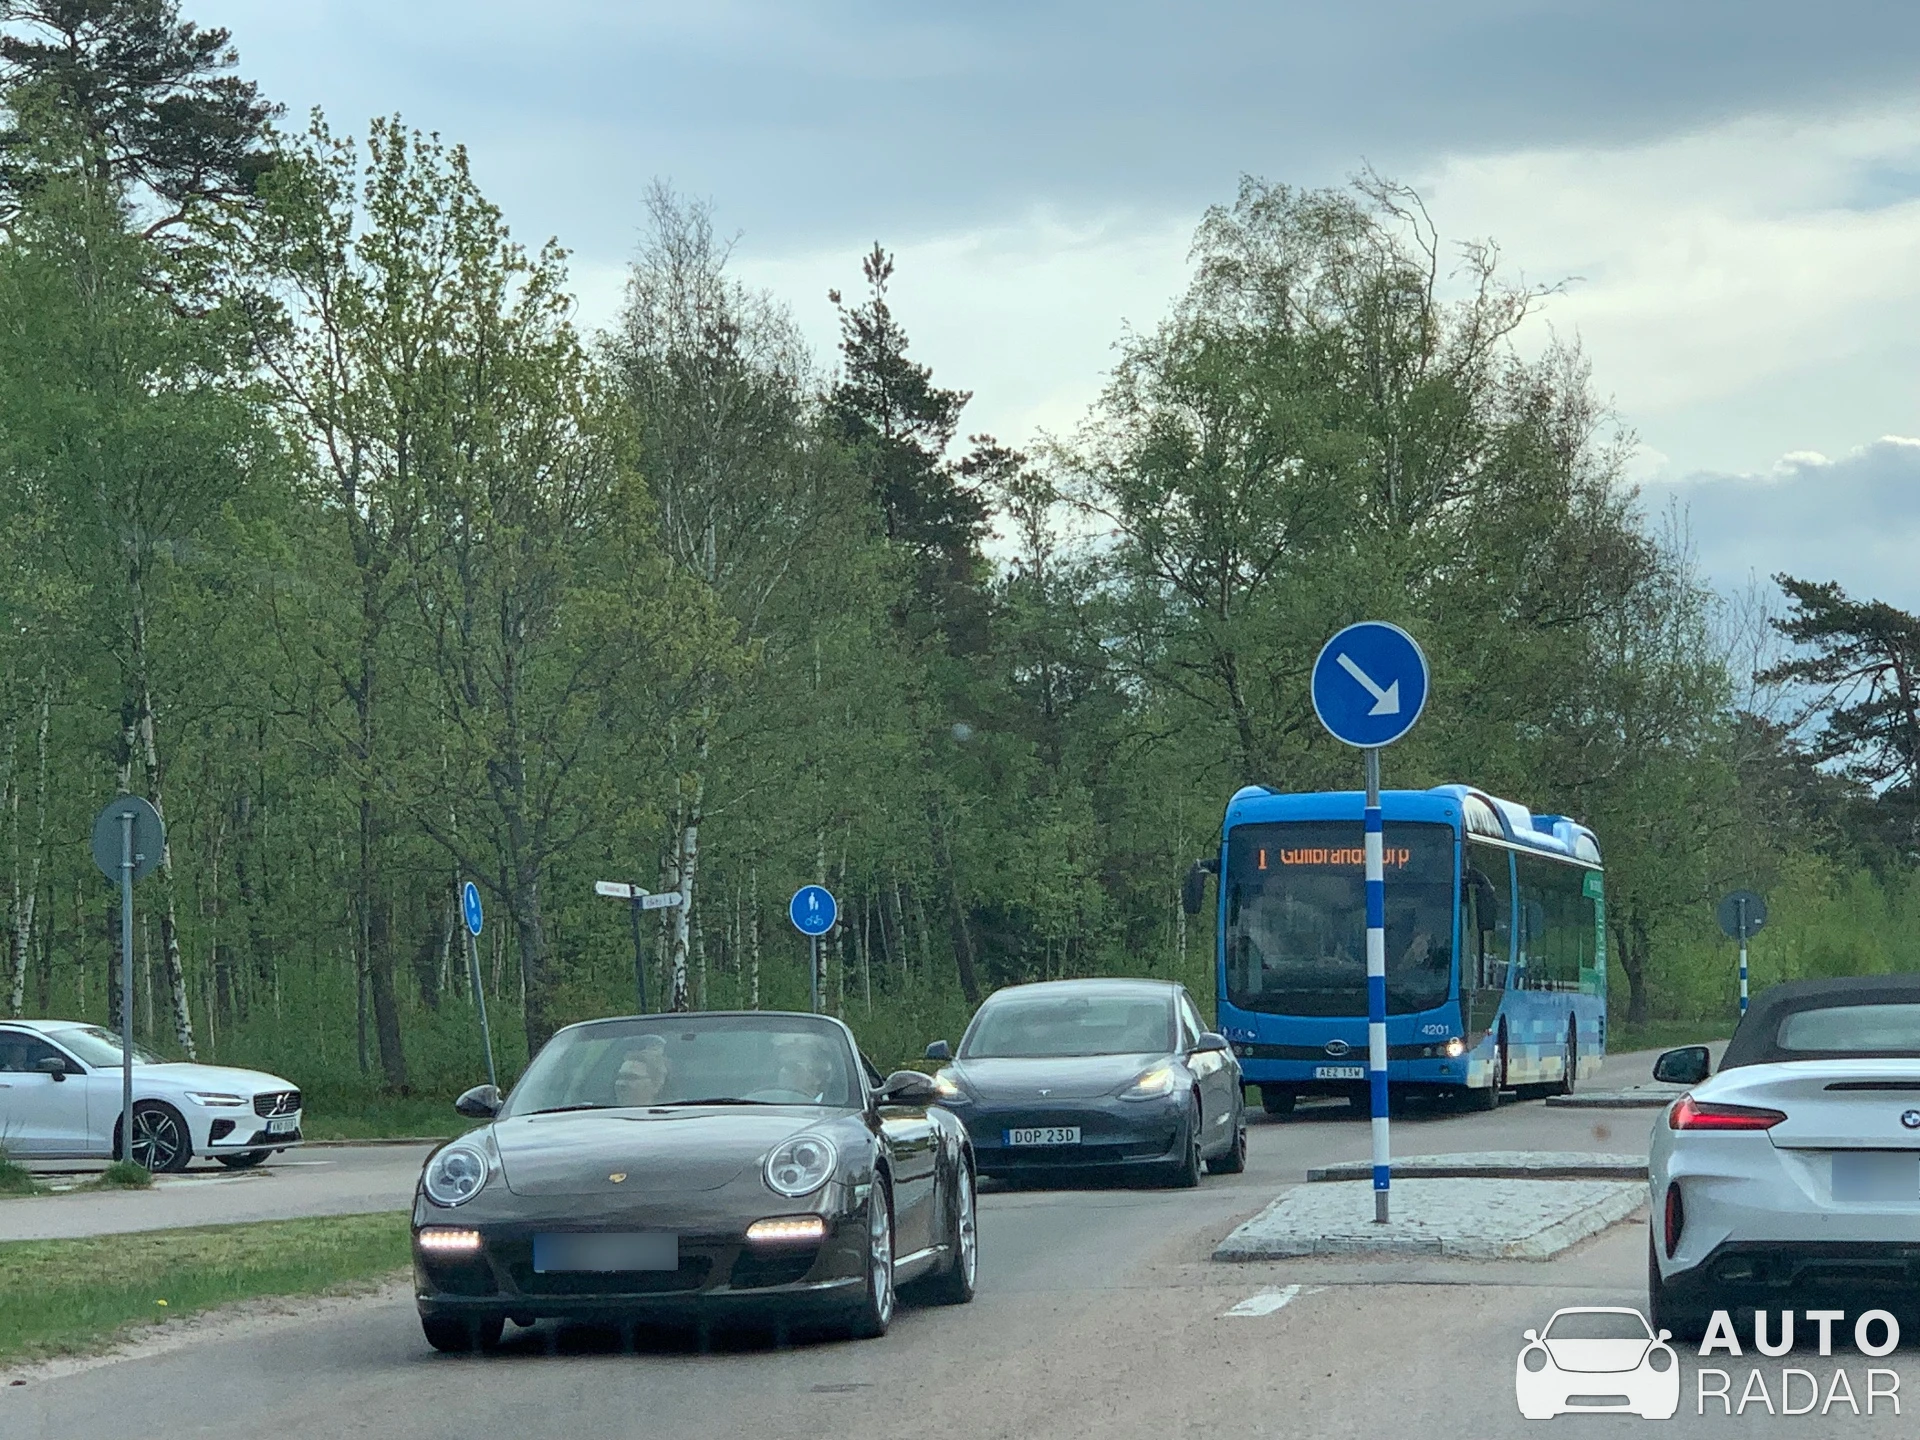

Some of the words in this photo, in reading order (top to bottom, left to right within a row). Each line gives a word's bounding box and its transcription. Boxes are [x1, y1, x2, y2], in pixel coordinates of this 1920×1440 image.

[1421, 1024, 1449, 1035] 4201
[1320, 1068, 1338, 1077] AEZ
[1015, 1130, 1041, 1143] DOP
[1047, 1129, 1074, 1142] 23D
